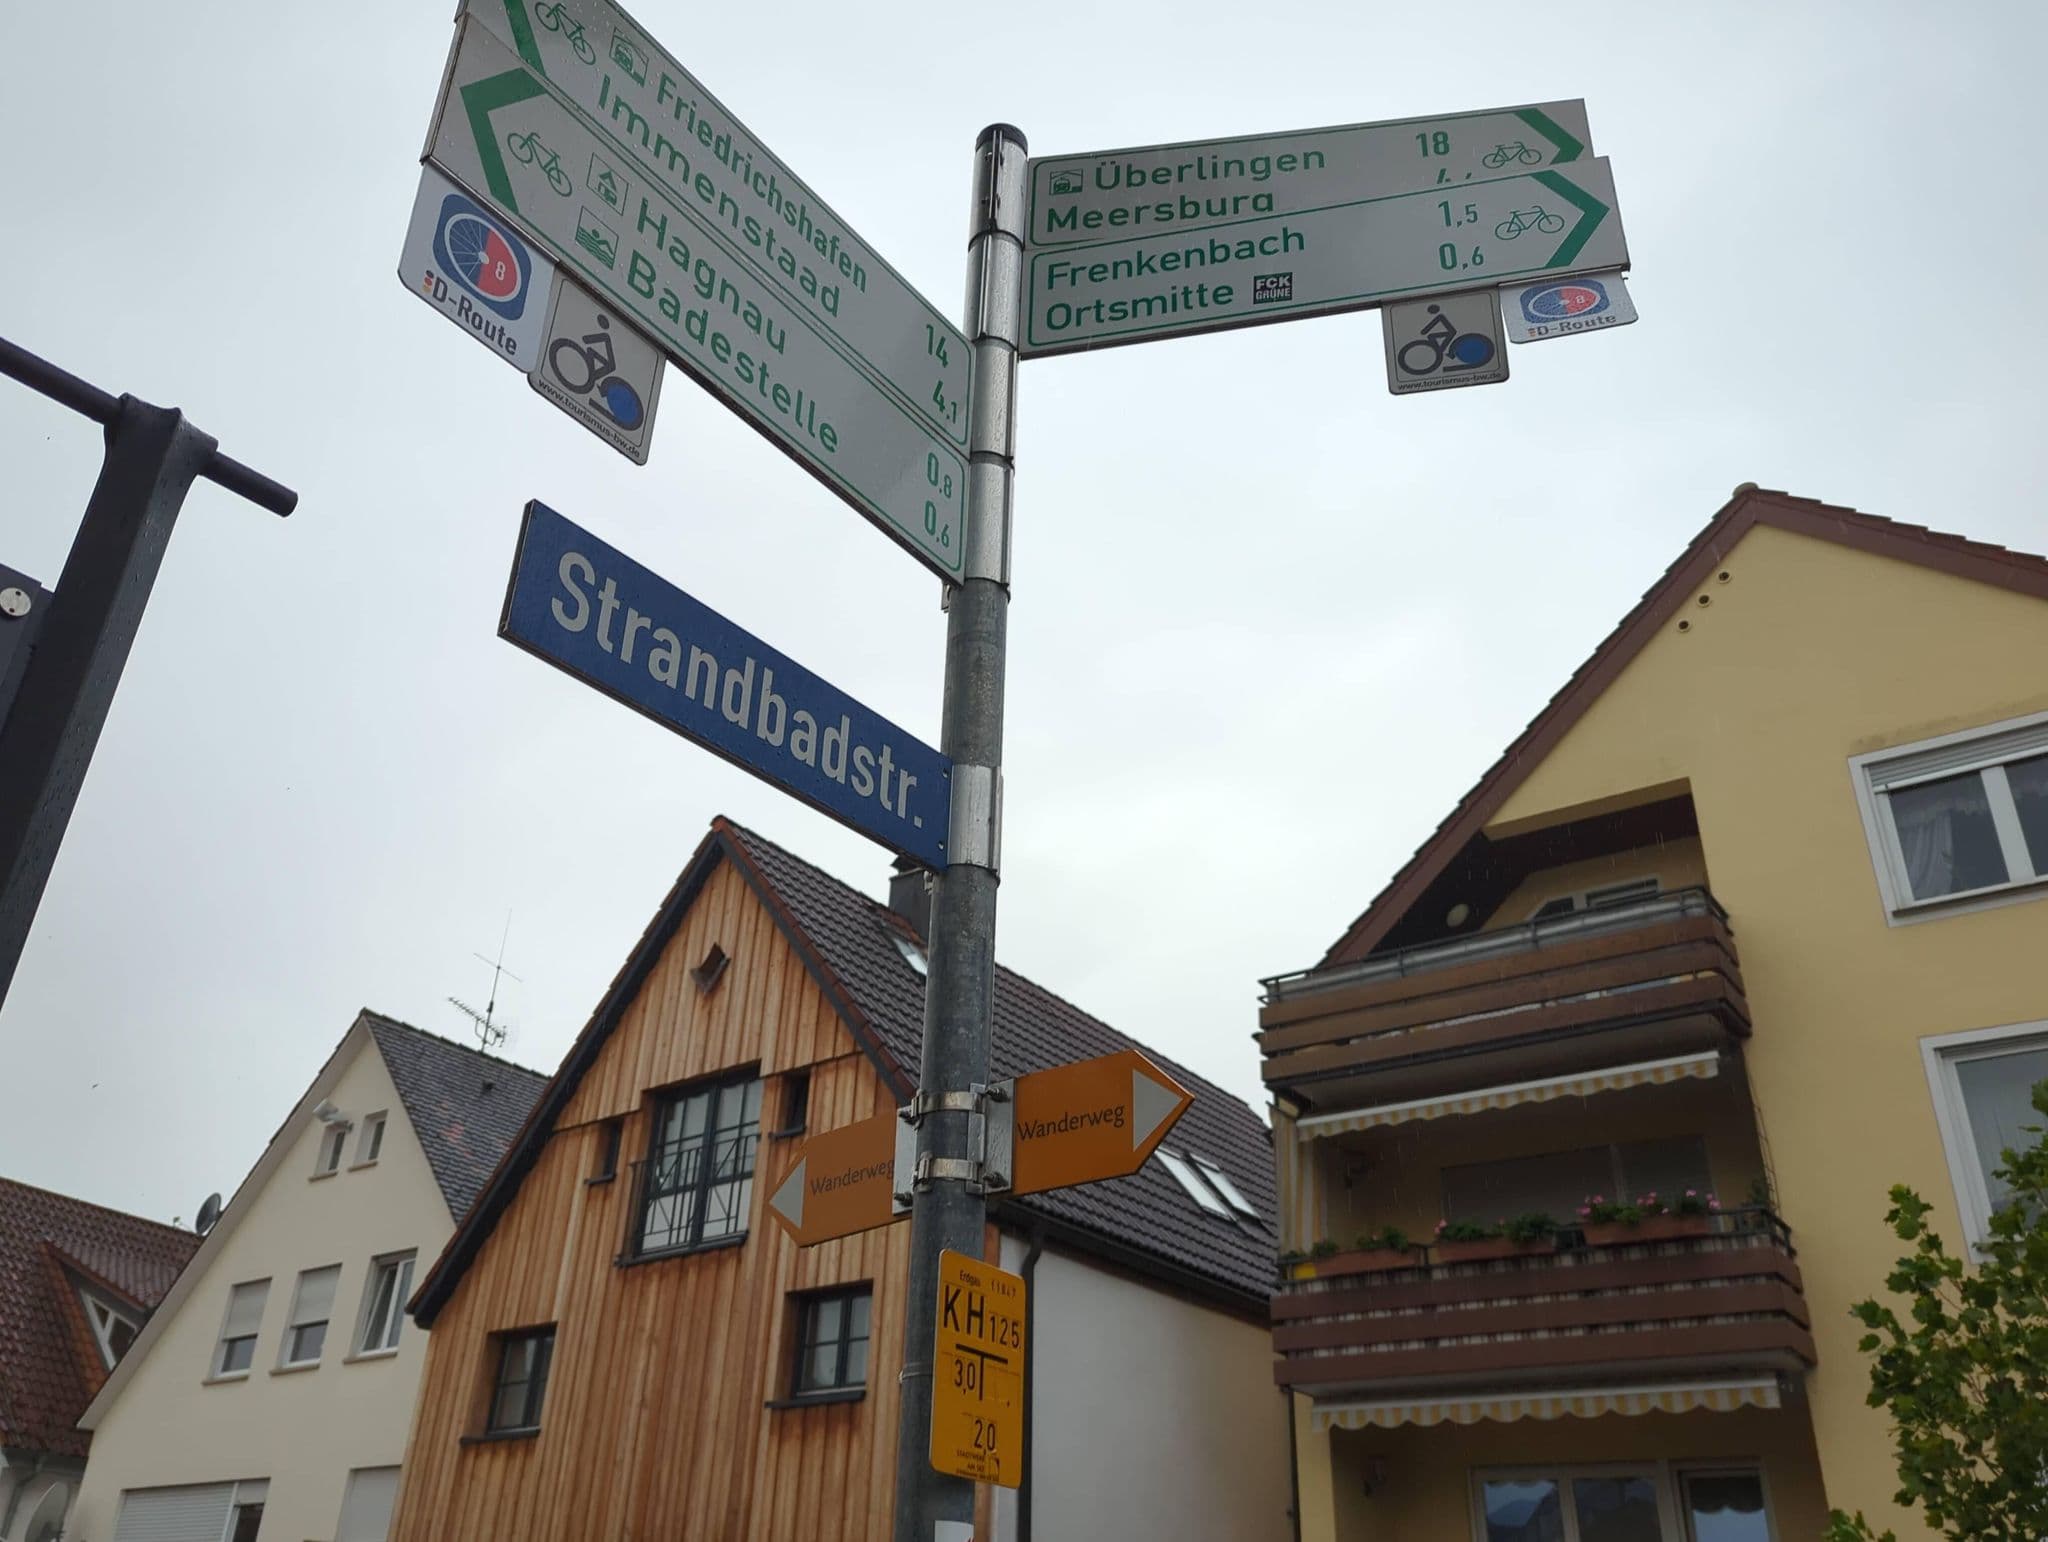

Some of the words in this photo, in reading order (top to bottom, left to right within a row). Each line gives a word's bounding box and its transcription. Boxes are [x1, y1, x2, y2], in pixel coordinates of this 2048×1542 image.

[1416, 131, 1450, 157] 18
[657, 72, 867, 293] Friedrichshafen
[1095, 146, 1325, 191] Überlingen
[598, 74, 840, 317] Immenstaad
[1438, 200, 1478, 227] 1,5
[494, 261, 506, 281] 8
[636, 197, 786, 355] Hagnau
[1047, 226, 1305, 290] Frenkenbach
[1439, 242, 1484, 270] 0,6
[1255, 286, 1292, 301] GRÜNE
[1256, 273, 1291, 291] FCK
[432, 277, 518, 356] D-Route
[1047, 282, 1234, 330] Ortsmitte
[1536, 314, 1617, 336] D-Route
[627, 249, 838, 453] Badestelle
[926, 324, 949, 369] 14
[1399, 372, 1501, 391] www.tourismus-bw.de
[538, 378, 641, 459] www.tourismus-bw.de
[550, 551, 923, 829] Strandbadstr.
[1017, 1104, 1126, 1142] Wanderweg
[810, 1159, 894, 1196] Wanderweg
